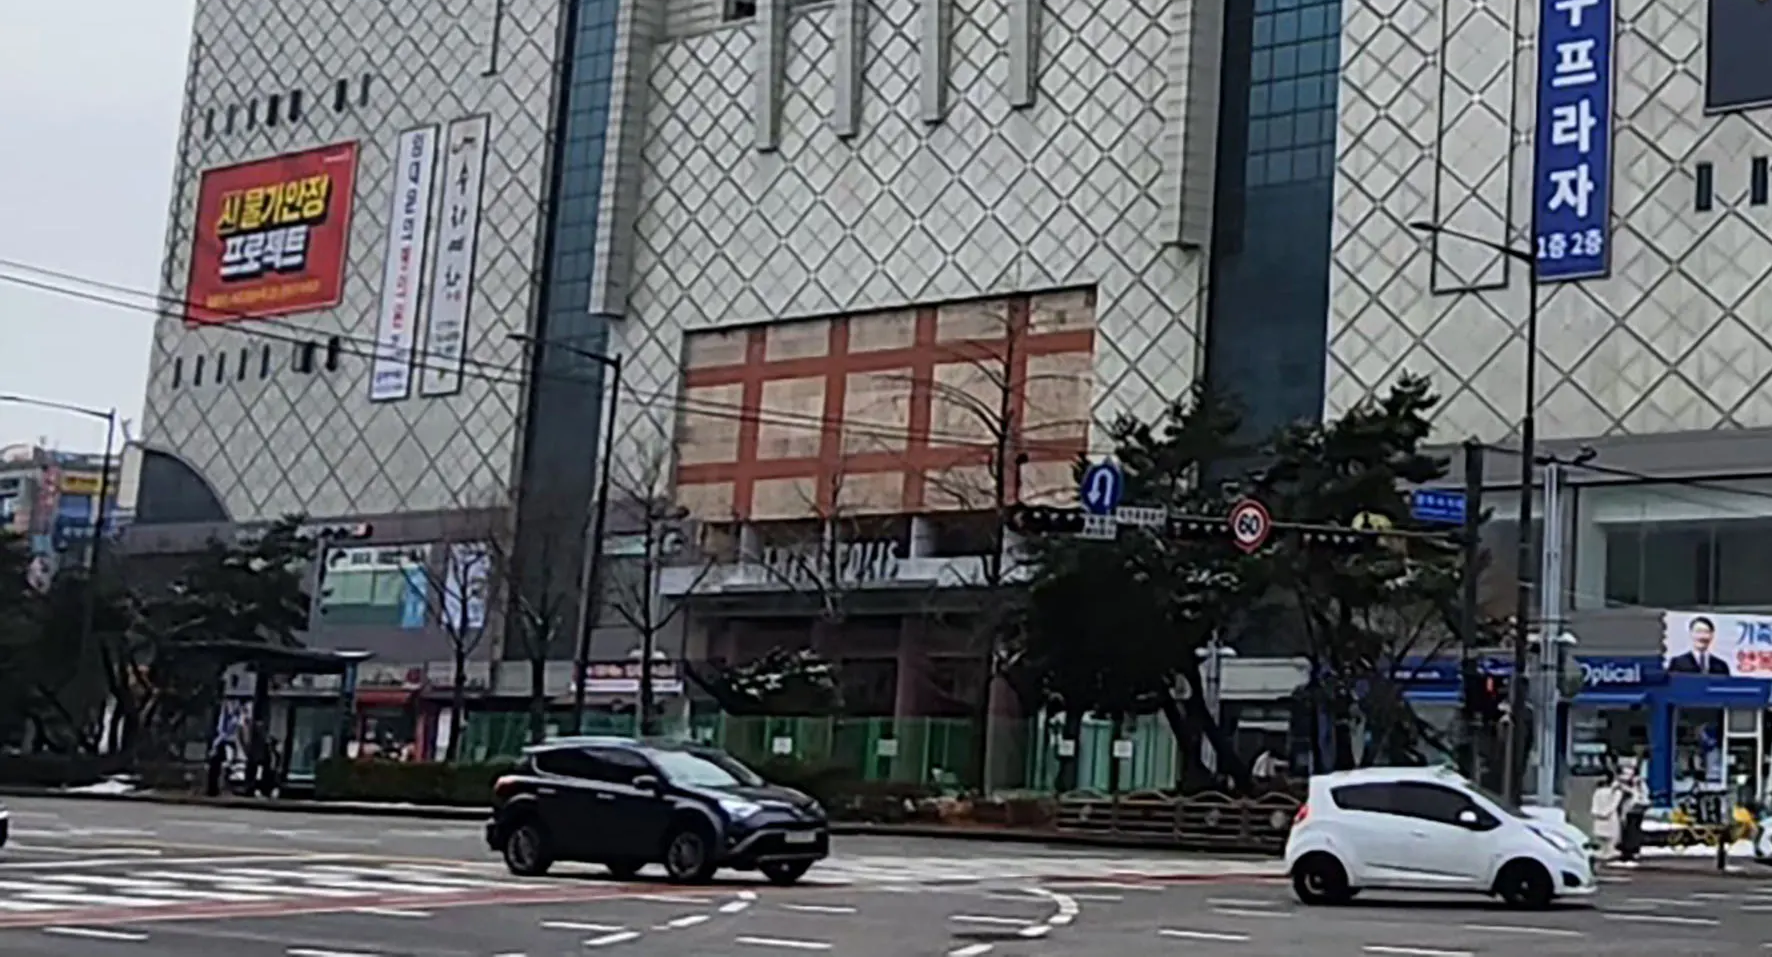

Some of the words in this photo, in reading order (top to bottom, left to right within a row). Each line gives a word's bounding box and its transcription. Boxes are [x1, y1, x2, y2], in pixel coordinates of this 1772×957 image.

[219, 225, 309, 276] 프로젝트
[1536, 232, 1567, 260] 1층
[1570, 229, 1604, 256] 2층
